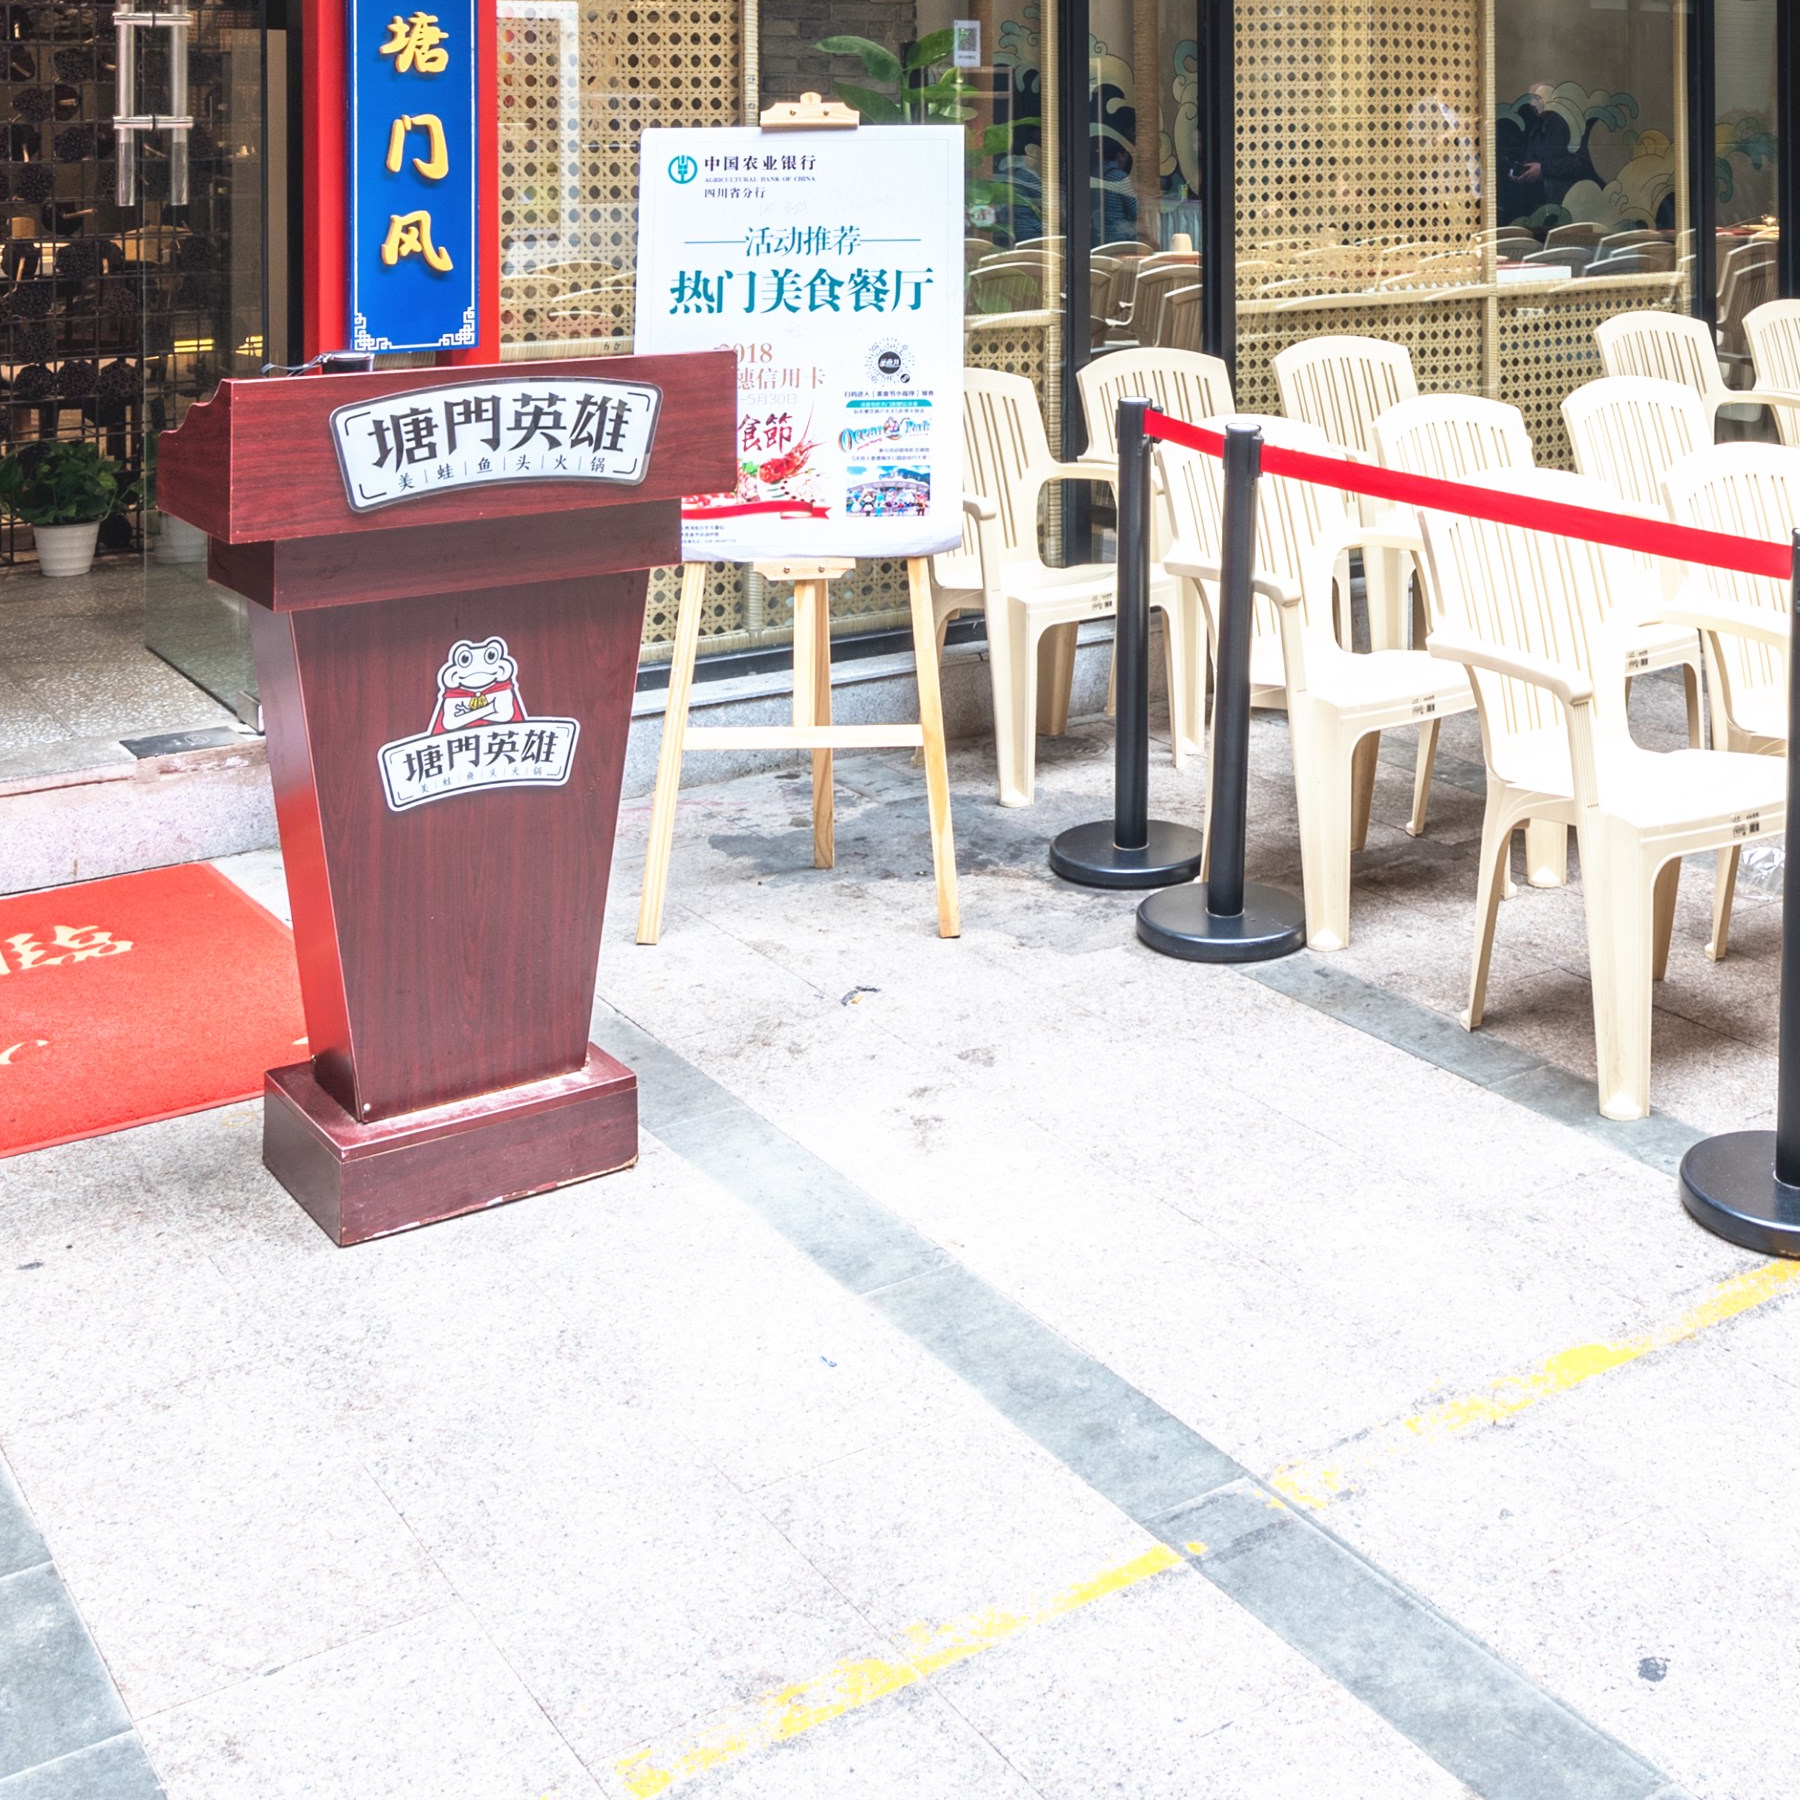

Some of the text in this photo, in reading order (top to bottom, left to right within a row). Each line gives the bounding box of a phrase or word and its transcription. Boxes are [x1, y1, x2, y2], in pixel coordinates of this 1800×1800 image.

[704, 155, 816, 171] 中国农业银行
[704, 187, 766, 198] 四川省分行
[744, 225, 861, 257] 活动推荐
[669, 267, 934, 315] 热门美食餐厅
[366, 392, 633, 473] 塘門英雄
[402, 729, 559, 784] 塘門英雄
